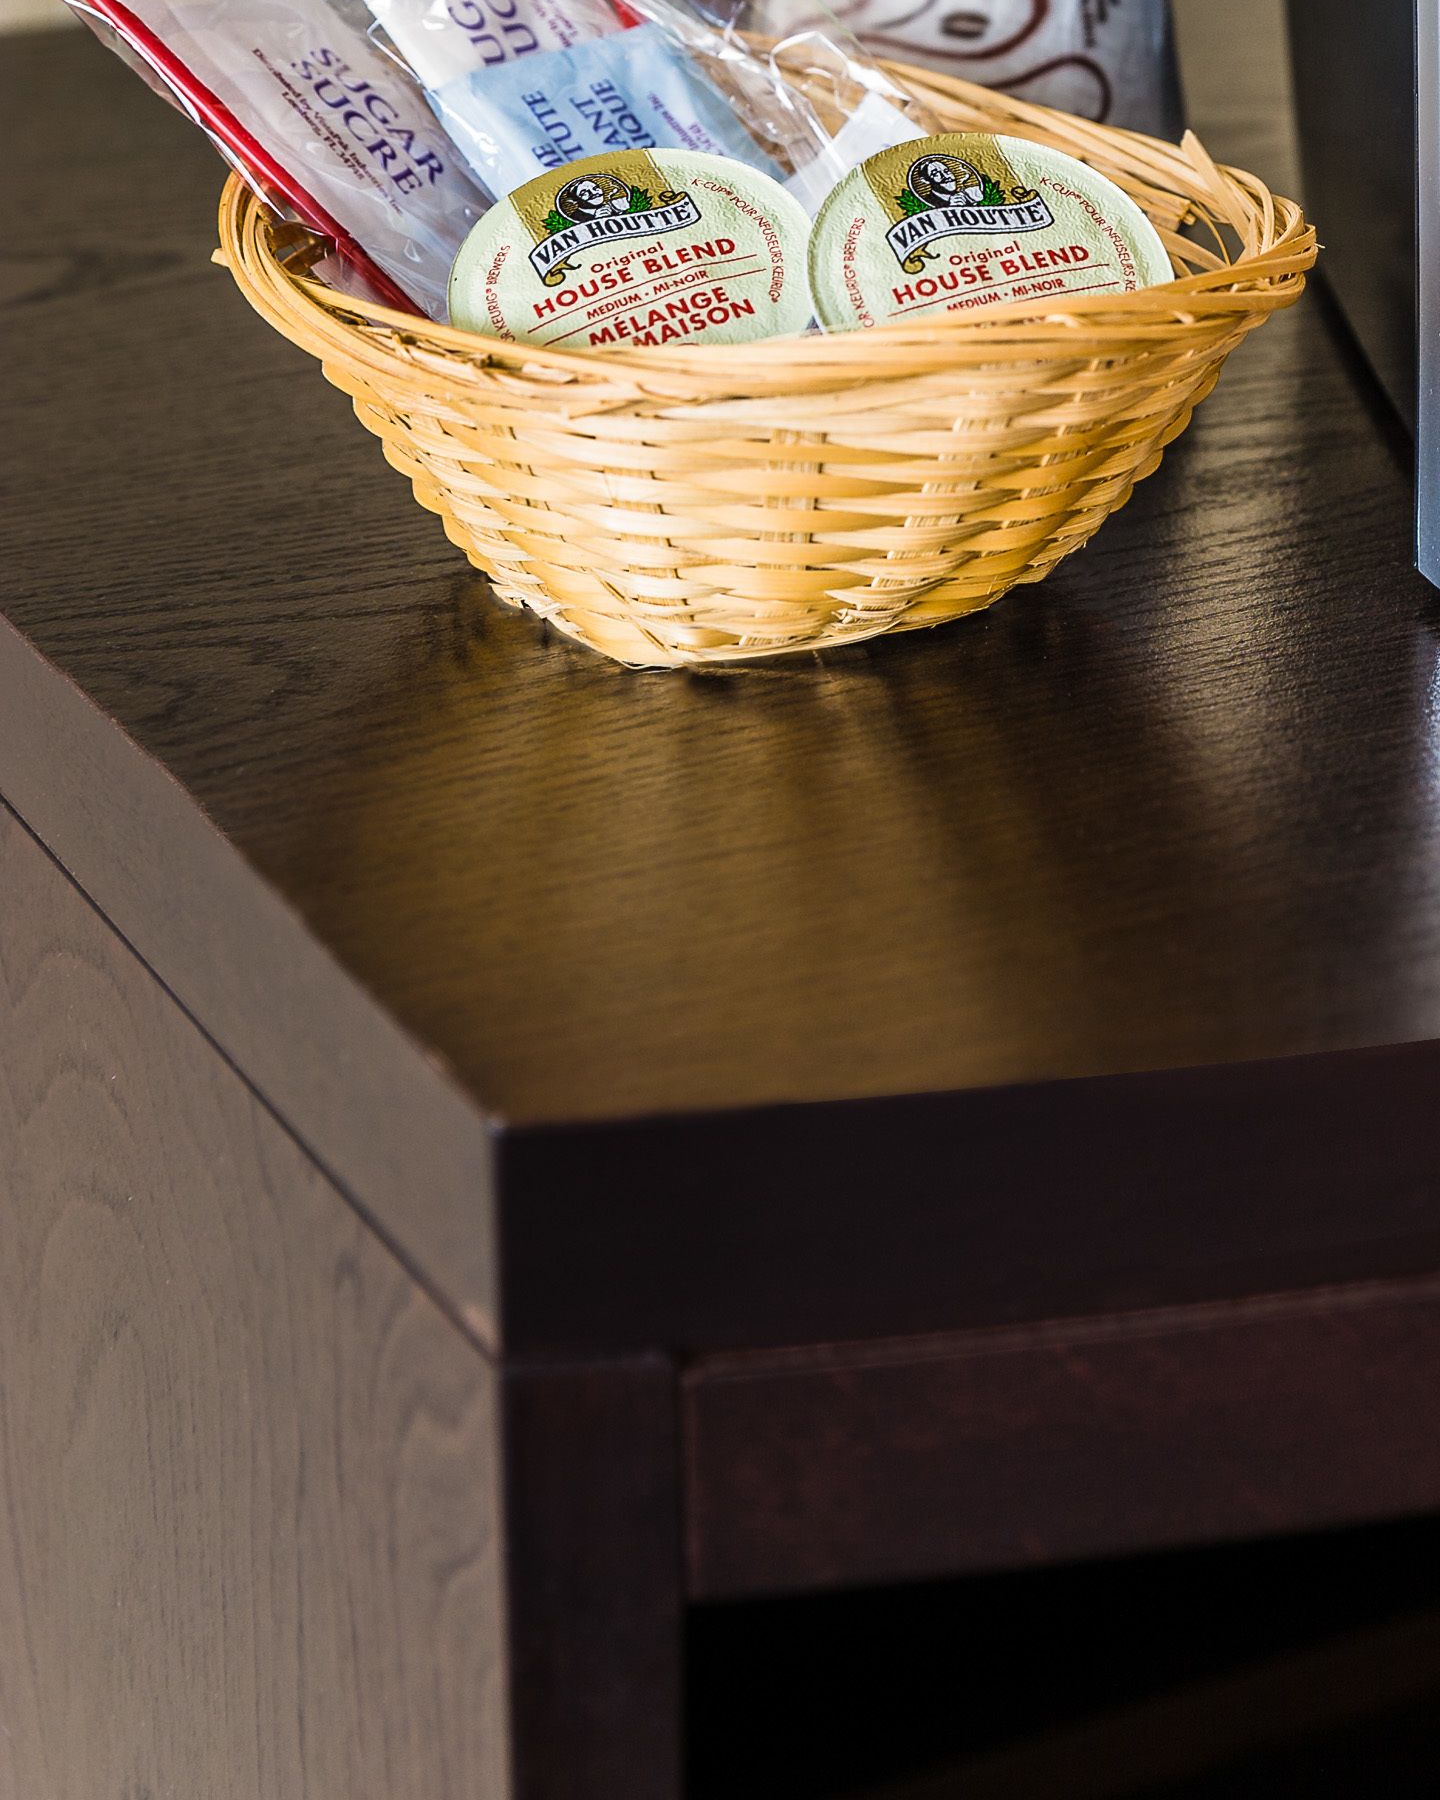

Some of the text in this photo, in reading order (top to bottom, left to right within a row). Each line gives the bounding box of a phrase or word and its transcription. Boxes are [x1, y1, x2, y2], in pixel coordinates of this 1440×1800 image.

[291, 60, 423, 195] SUCRE
[310, 48, 444, 186] SUGAR
[521, 90, 583, 162] TUTE
[569, 97, 630, 149] ANT
[590, 78, 656, 149] IQUE
[535, 229, 579, 266] VAN
[730, 195, 757, 217] POUR
[753, 215, 784, 264] INFUSEURS
[844, 217, 866, 261] BREWERS
[893, 213, 937, 249] VAN
[949, 241, 1021, 265] Original
[1080, 200, 1106, 226] POUR
[1102, 225, 1135, 277] INFUSEURS
[486, 245, 511, 285] BREWERS
[532, 237, 736, 319] HOUSE BLEND
[590, 241, 664, 274] Original
[892, 245, 1090, 304] HOUSE BLEND
[586, 269, 710, 320] MEDIUM MI-NOIR
[1011, 278, 1066, 298] MI-NOIR
[588, 286, 730, 347] MÉLANGE
[631, 298, 756, 346] MAISON
[858, 311, 874, 328] OR
